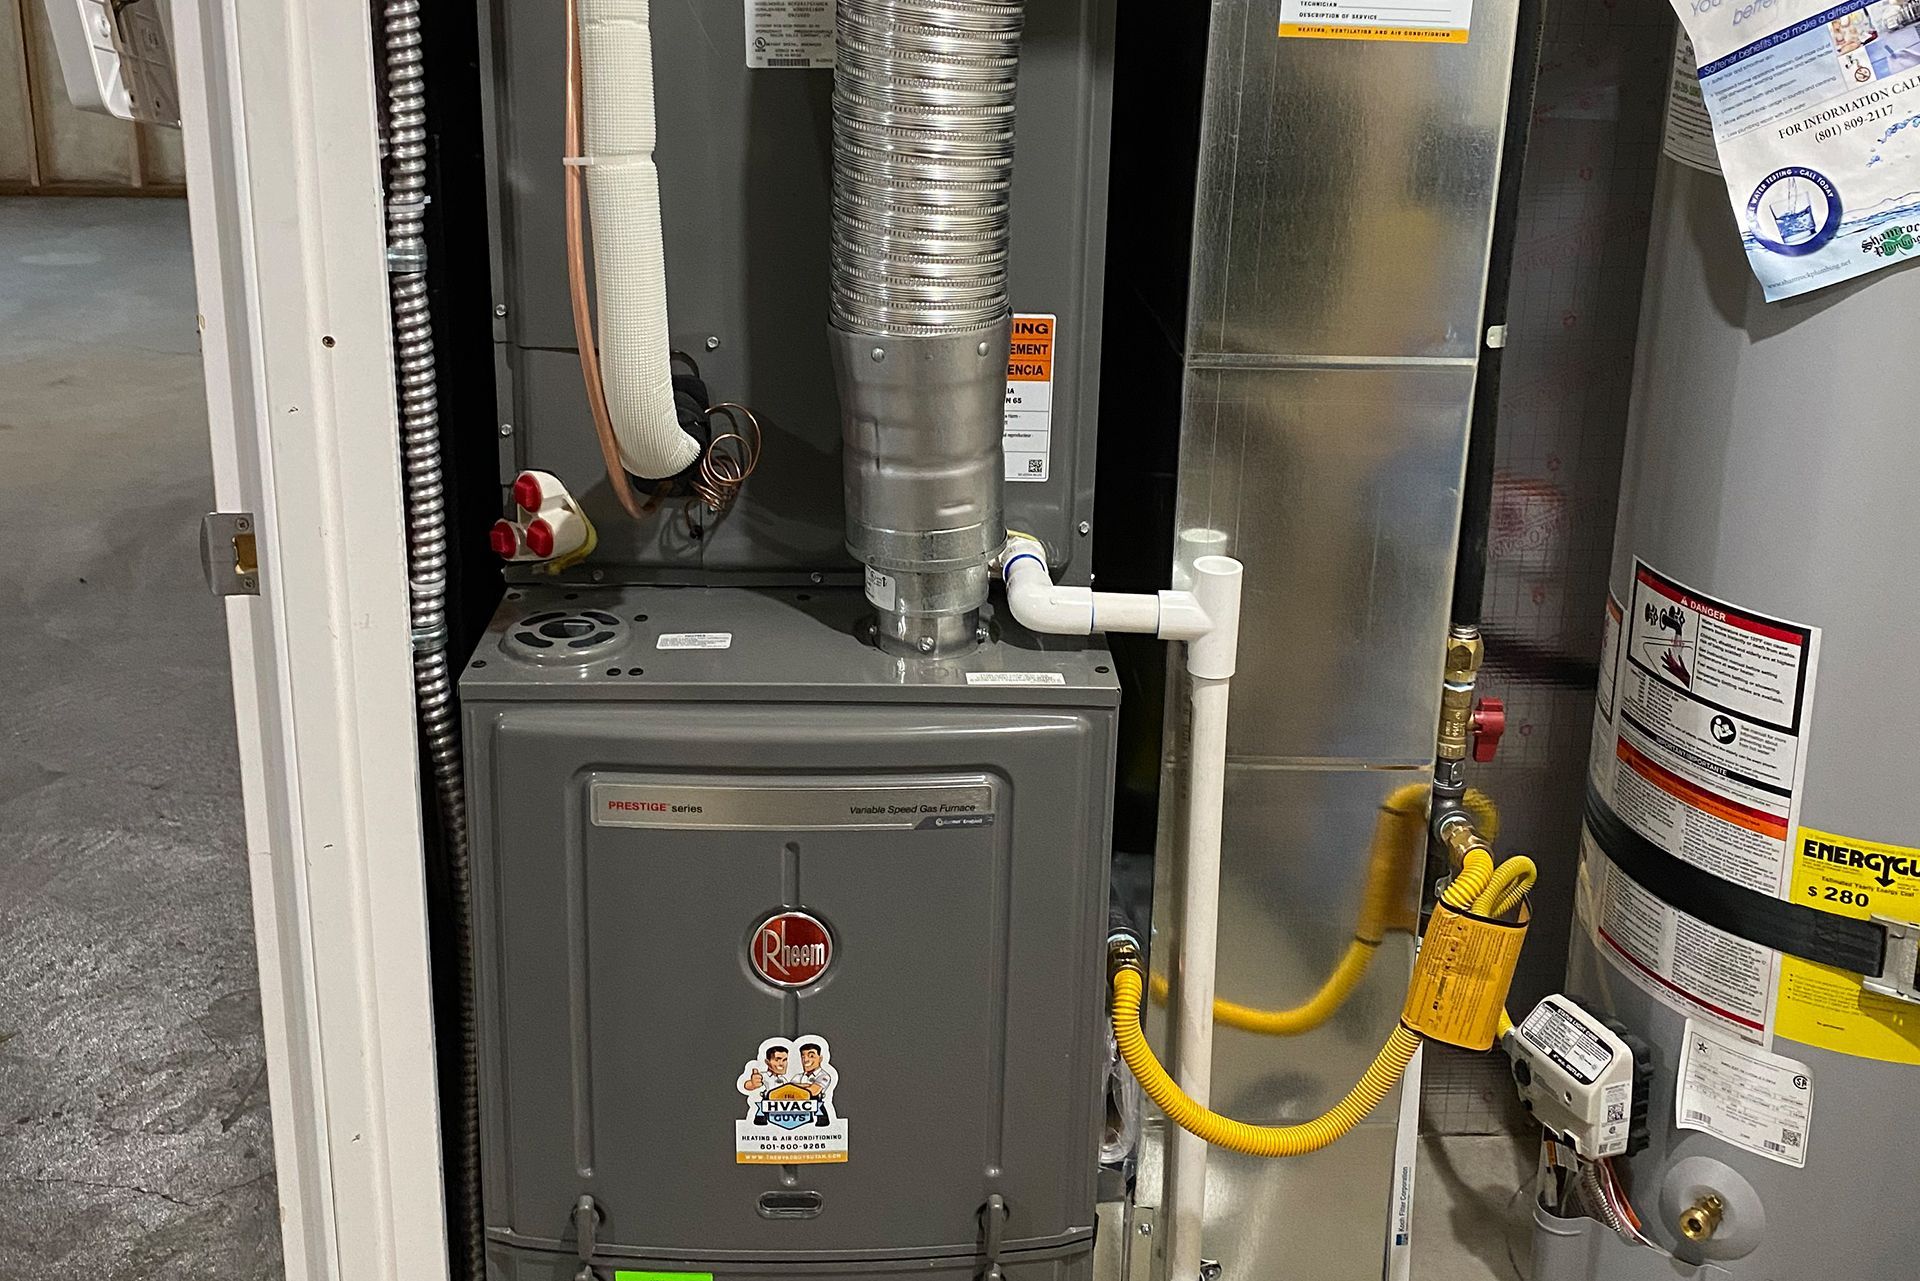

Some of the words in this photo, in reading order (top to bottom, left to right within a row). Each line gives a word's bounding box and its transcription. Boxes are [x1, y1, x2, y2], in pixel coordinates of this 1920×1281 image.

[1703, 55, 1738, 74] Softener
[1737, 39, 1772, 58] benefits
[1772, 31, 1789, 41] that
[1791, 19, 1818, 33] make
[1779, 123, 1803, 139] FOR
[1804, 88, 1890, 130] INFORMATION
[1815, 124, 1842, 143] (801)
[1844, 104, 1894, 131] 809-2117
[1750, 184, 1767, 204] WATER
[1766, 169, 1793, 184] TESTING
[1800, 169, 1817, 180] CALL
[1817, 177, 1834, 198] TODAY
[1768, 259, 1852, 289] www.shamrockplumbing.net
[1012, 323, 1049, 335] ING
[1010, 344, 1048, 355] EMENT
[1008, 365, 1044, 375] ENCIA
[1690, 600, 1727, 622] DANGER
[608, 801, 667, 812] PRESTIGE
[671, 804, 703, 813] series
[850, 805, 886, 814] Variable
[888, 805, 917, 815] Speed
[920, 805, 937, 813] Gas
[940, 804, 976, 812] Furnace
[1807, 886, 1818, 897] $
[1823, 886, 1870, 908] 280
[1821, 876, 1856, 887] Estimated
[1855, 883, 1874, 892] Yearly
[1876, 887, 1898, 896] Energy
[1900, 889, 1914, 897] Cost
[762, 920, 825, 976] Rheem
[1557, 1009, 1573, 1023] STATUS
[1573, 1020, 1586, 1032] LIGHT
[768, 1101, 812, 1112] HVAC
[774, 1114, 806, 1122] GUYS
[1400, 1166, 1408, 1200] Corporation
